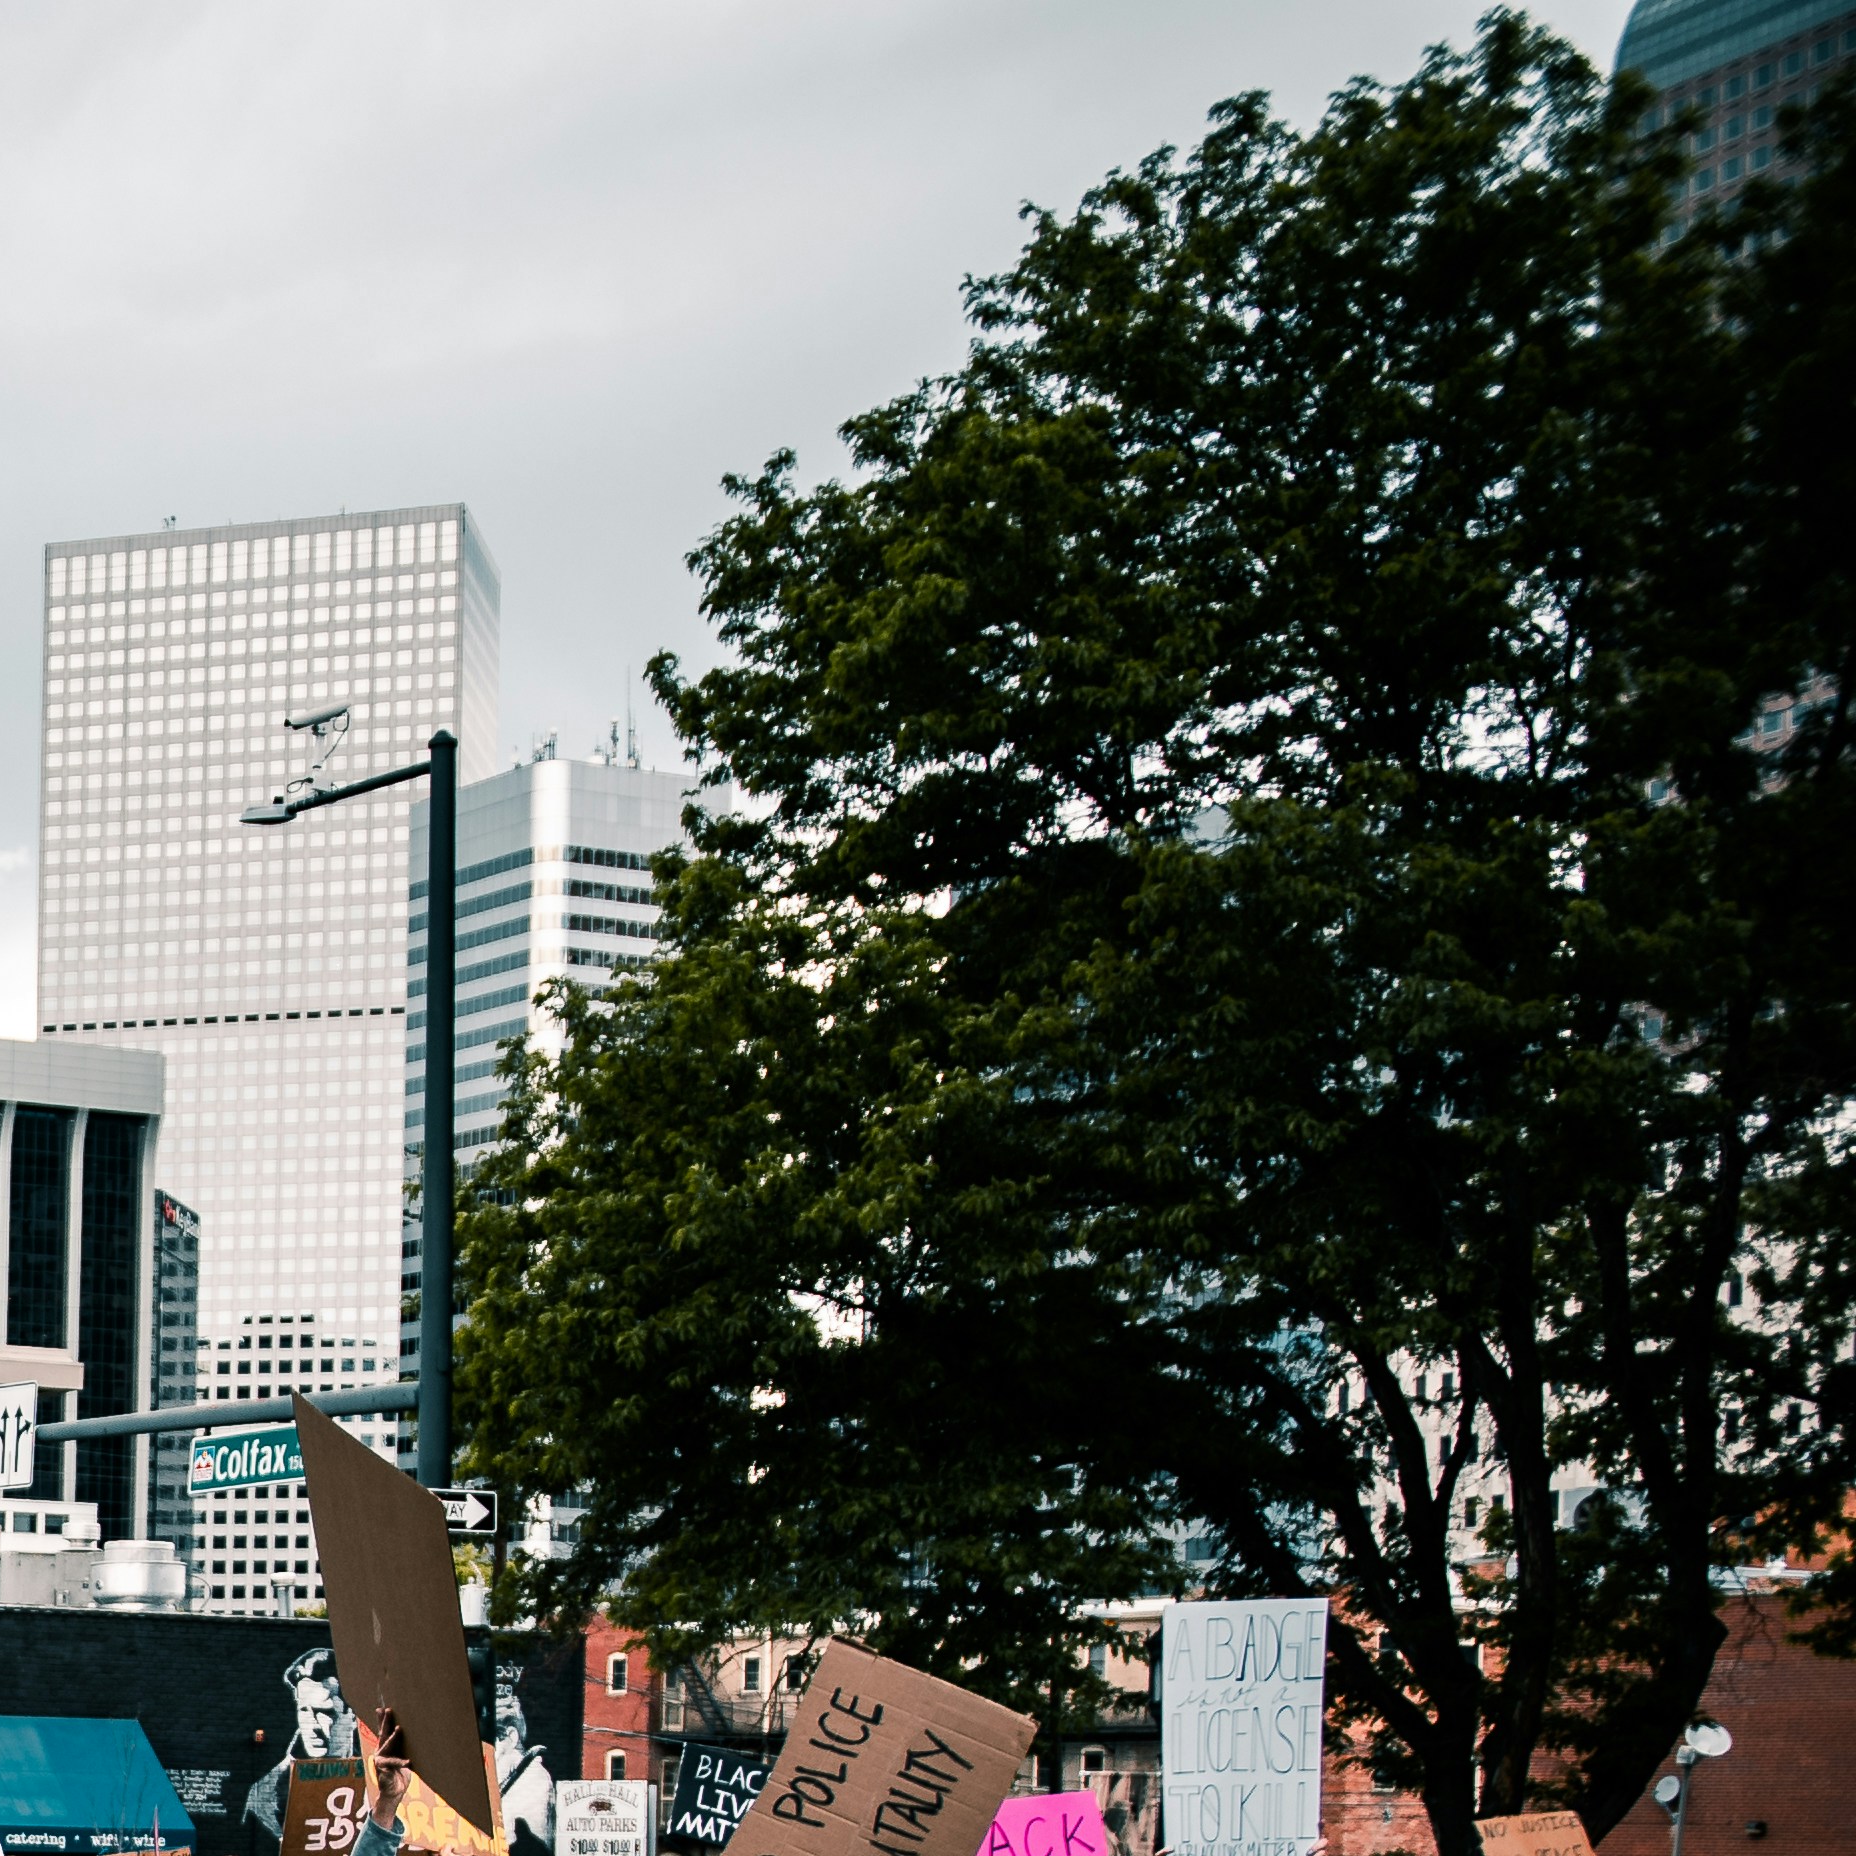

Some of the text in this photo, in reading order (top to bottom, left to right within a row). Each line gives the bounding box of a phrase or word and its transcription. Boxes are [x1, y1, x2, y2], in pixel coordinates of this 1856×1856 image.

[215, 1438, 288, 1481] Colfax
[1205, 1610, 1325, 1683] BADGE
[772, 1686, 886, 1829] POLICE
[1171, 1704, 1322, 1775] LICENSE
[694, 1753, 773, 1797] BLAC
[5, 1831, 67, 1850] catering
[566, 1817, 596, 1832] AUTO
